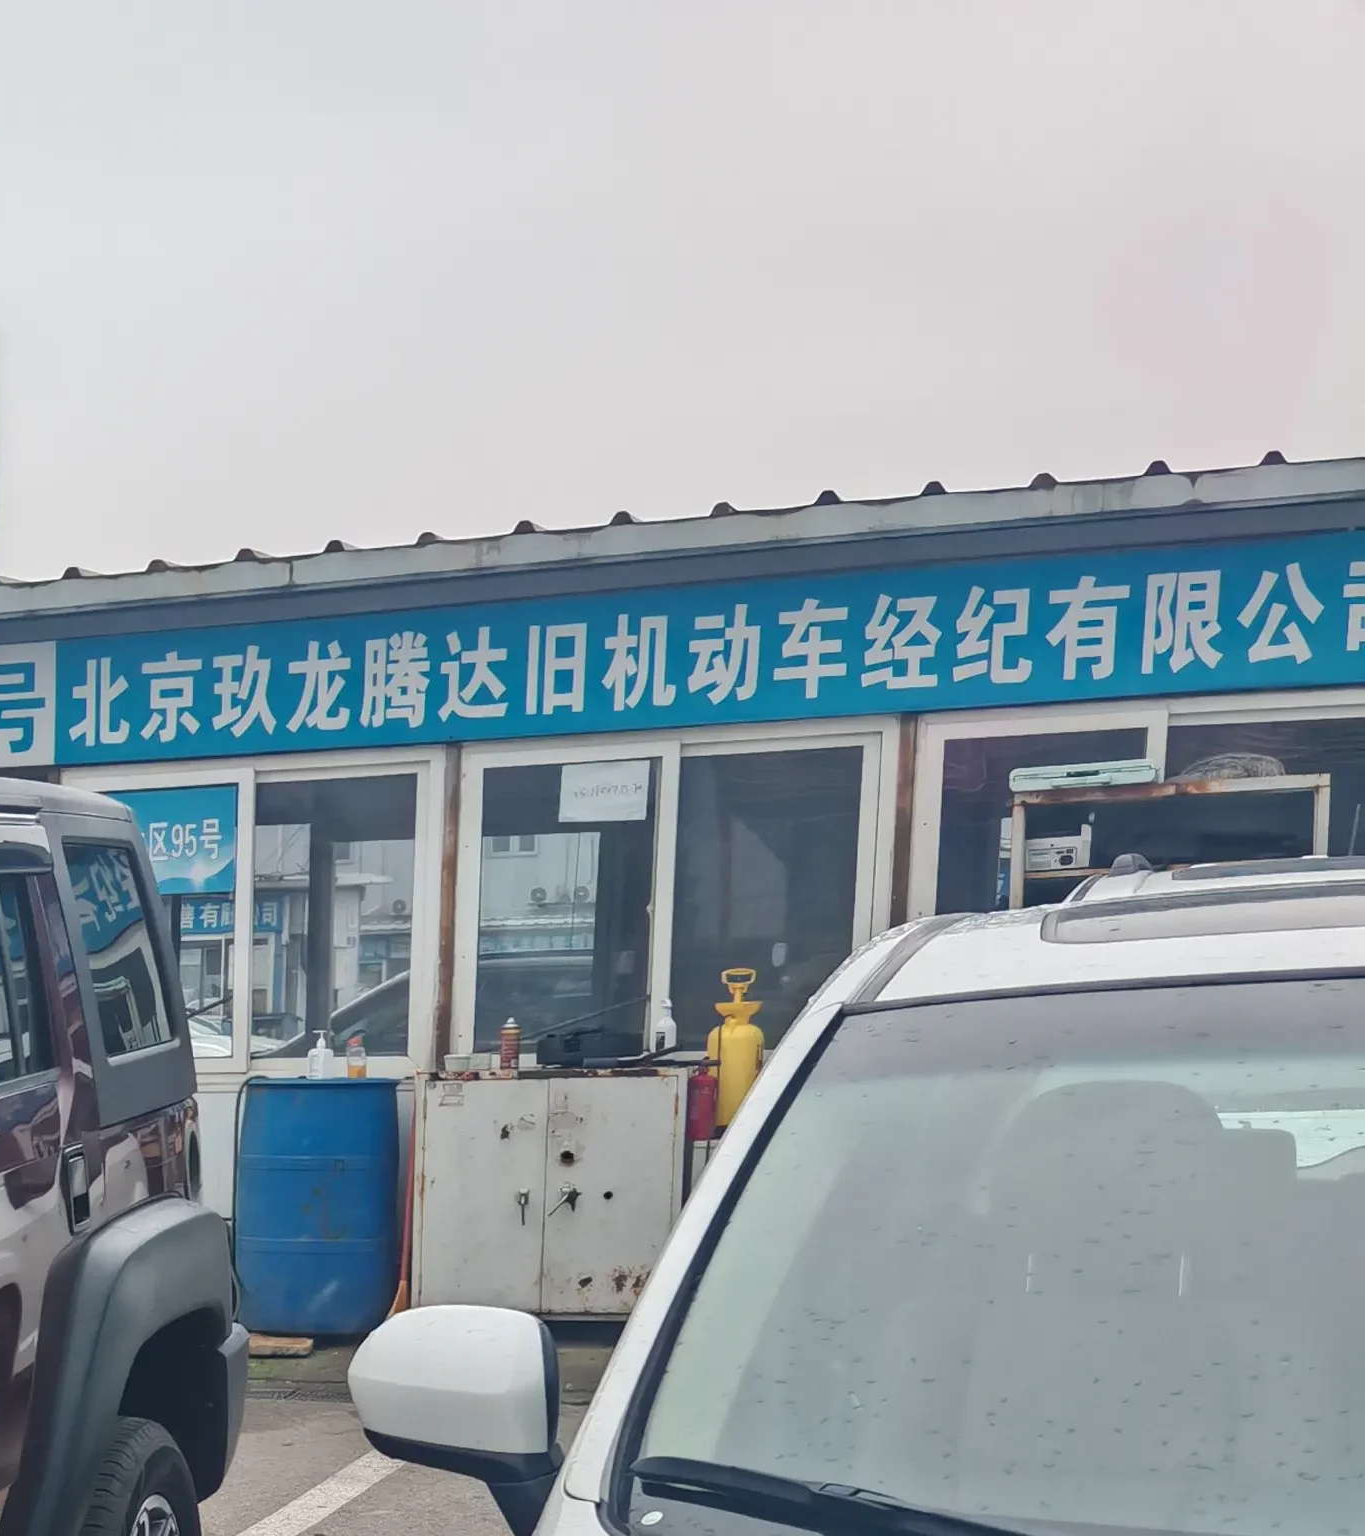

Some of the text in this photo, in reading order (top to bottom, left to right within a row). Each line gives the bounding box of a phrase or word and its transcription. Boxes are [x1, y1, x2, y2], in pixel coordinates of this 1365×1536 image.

[70, 561, 1365, 747] 北京玖龙腾达旧机动车经纪有限公
[142, 818, 222, 861] 区95号
